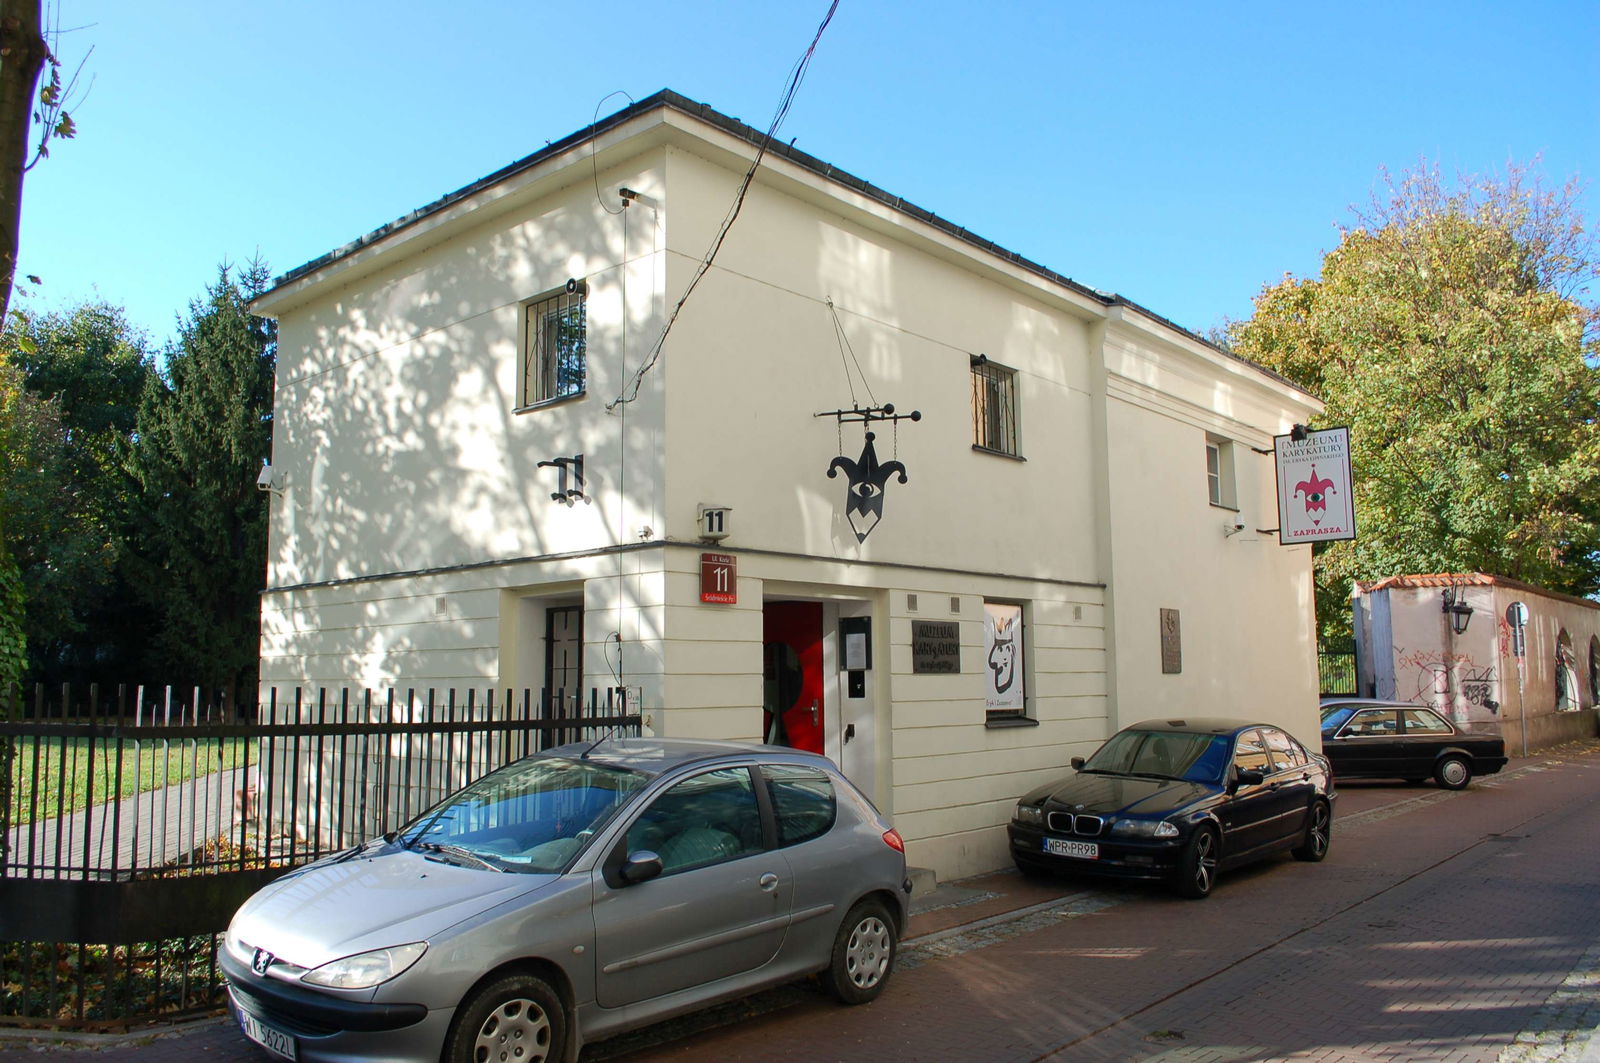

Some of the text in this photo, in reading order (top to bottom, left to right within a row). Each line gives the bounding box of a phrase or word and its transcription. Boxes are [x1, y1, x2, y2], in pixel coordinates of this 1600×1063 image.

[1282, 444, 1343, 458] KARYKATURY
[705, 510, 724, 532] 11
[1293, 526, 1342, 537] ZAPRASZA
[713, 566, 728, 592] 11
[1048, 840, 1097, 856] WPR PR98
[260, 1023, 294, 1058] 5622L
